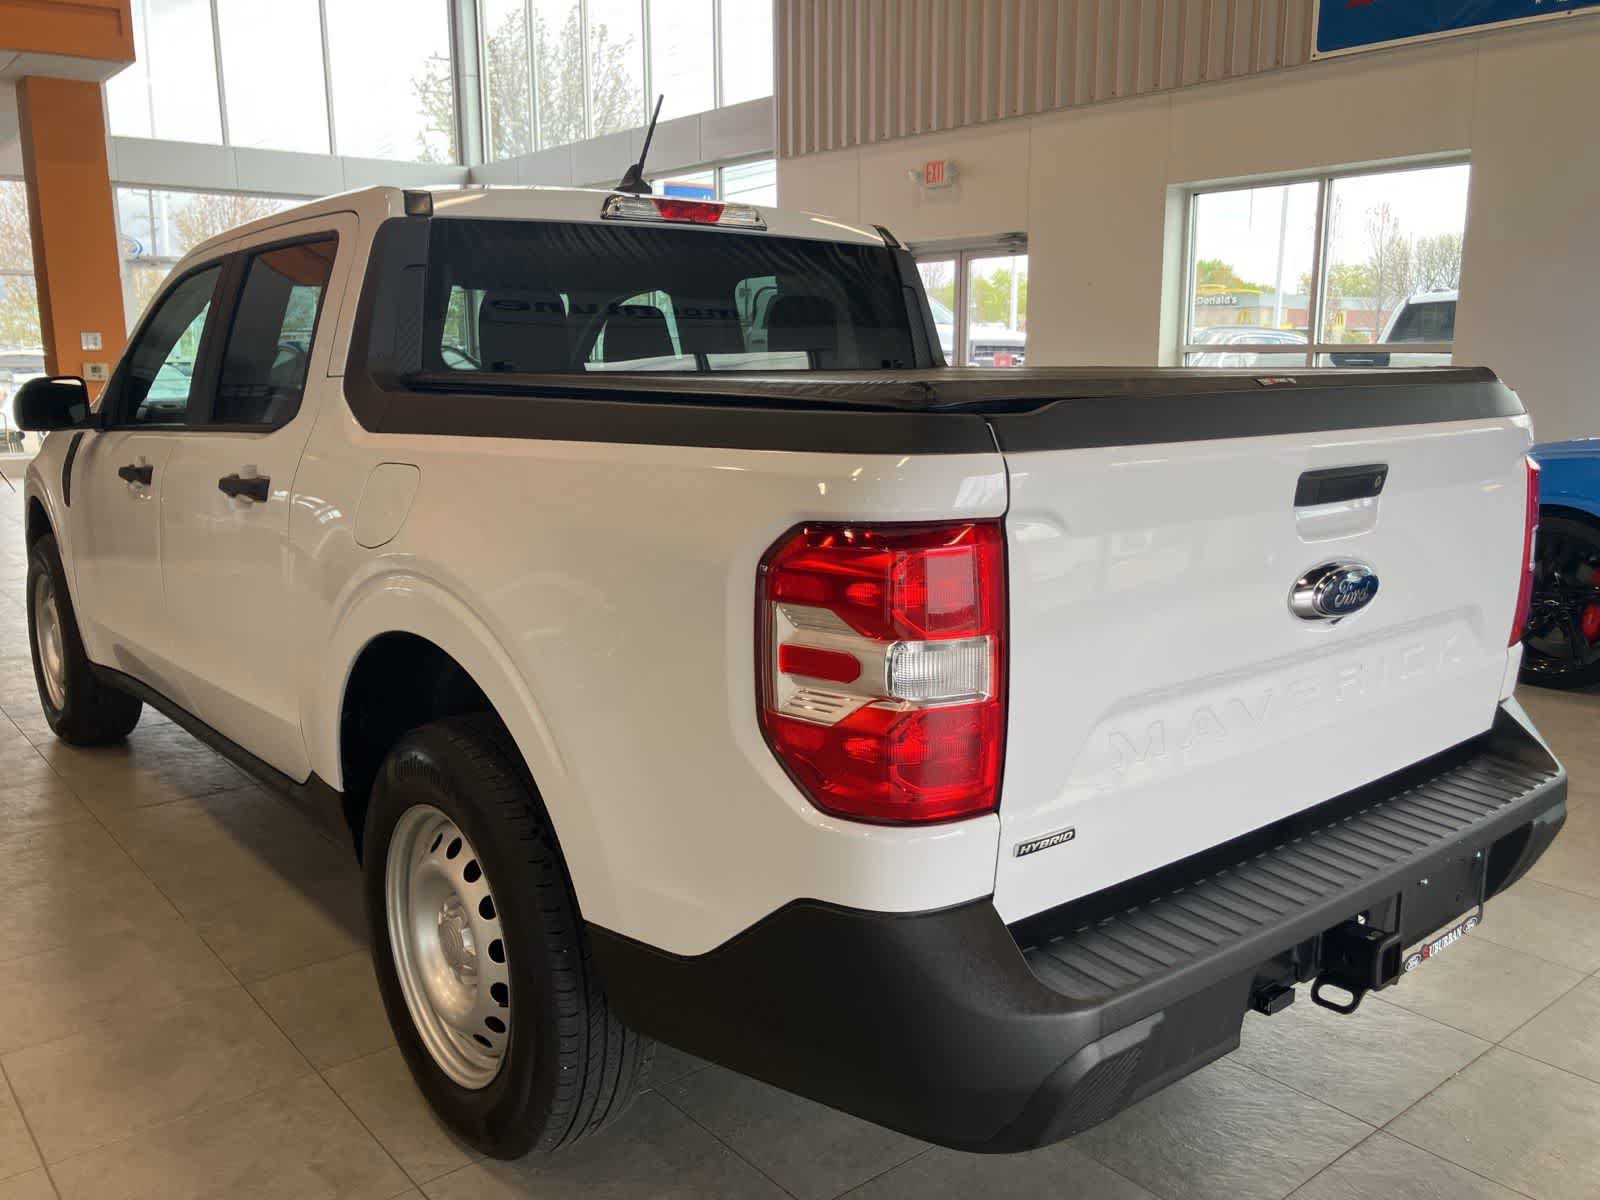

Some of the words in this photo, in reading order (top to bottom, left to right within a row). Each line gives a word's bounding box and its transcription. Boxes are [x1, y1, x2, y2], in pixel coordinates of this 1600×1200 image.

[926, 160, 945, 184] EXIT
[1334, 579, 1371, 608] Ford
[1107, 631, 1466, 772] MAVERICK
[1019, 830, 1074, 855] HYBRID
